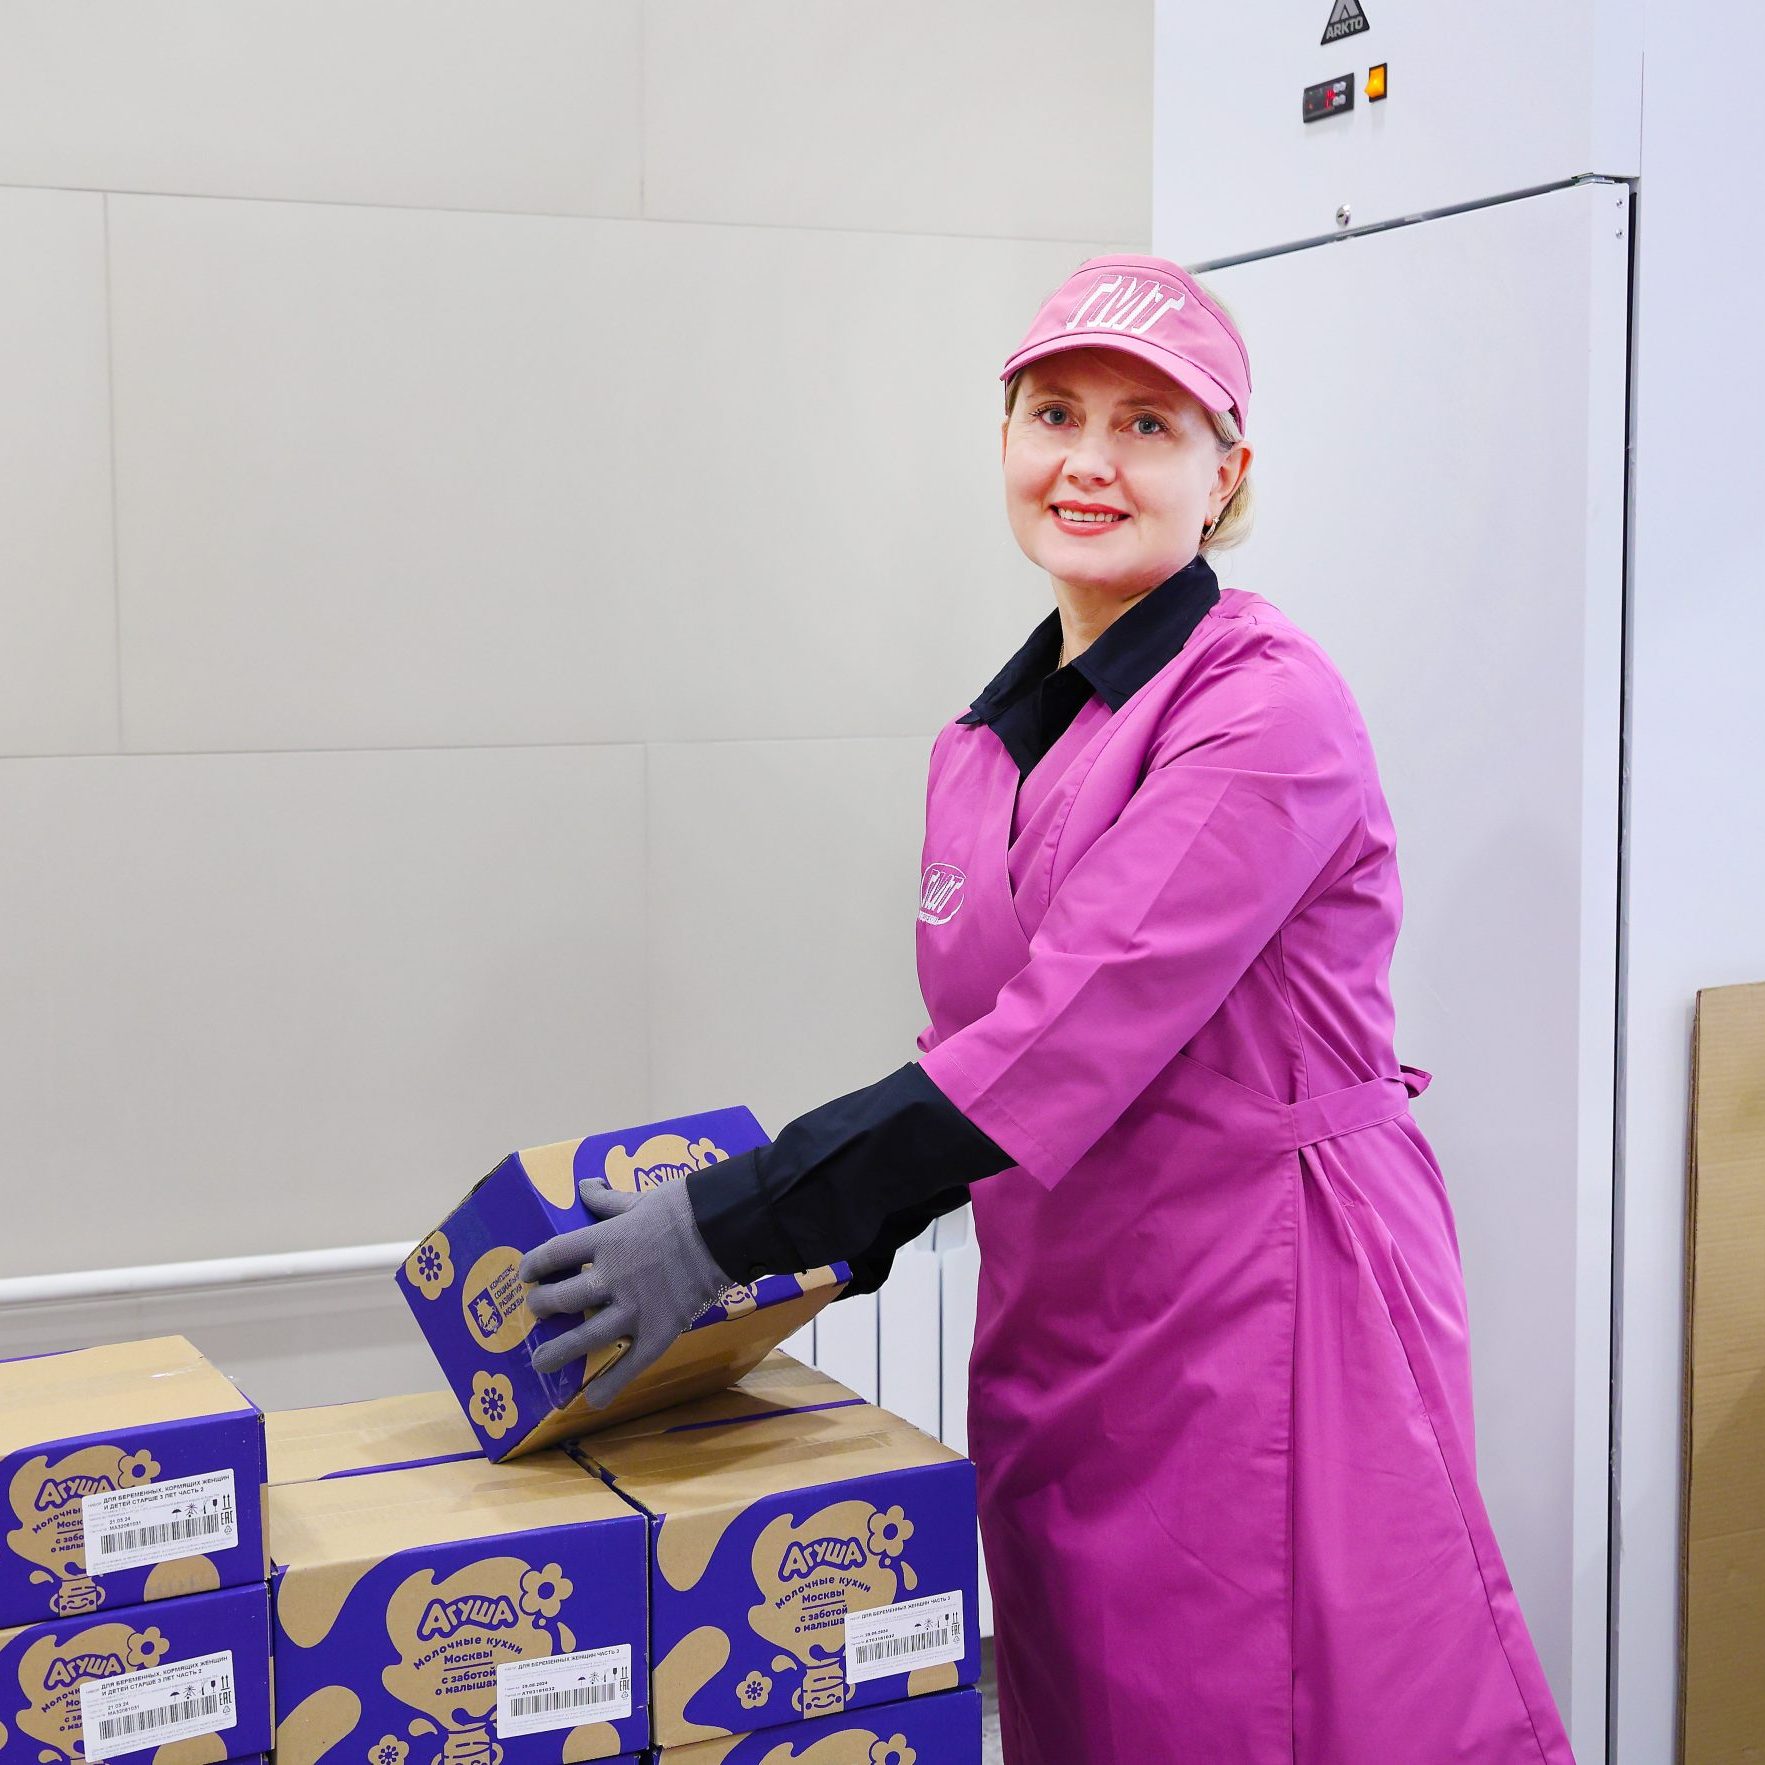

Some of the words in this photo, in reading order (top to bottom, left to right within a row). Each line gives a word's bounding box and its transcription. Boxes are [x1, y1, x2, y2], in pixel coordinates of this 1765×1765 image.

[1325, 16, 1364, 39] ARKTO
[489, 1264, 515, 1291] КОМПЛЕКС
[499, 1283, 524, 1309] РАЗВИТИЯ
[503, 1295, 525, 1318] МОСКВЫ
[103, 1496, 117, 1504] ДЛЯ
[165, 1481, 201, 1493] КОРМЯЩИХ
[202, 1475, 230, 1486] ЖЕНЩИН
[110, 1500, 131, 1510] ДЕТЕЙ
[132, 1495, 159, 1505] СТАРШЕ
[164, 1491, 177, 1499] ЛЕТ
[178, 1488, 199, 1497] ЧАСТЬ
[32, 1507, 82, 1534] Молочны
[57, 1520, 83, 1530] Моск
[59, 1542, 84, 1552] малы
[63, 1533, 84, 1543] забо
[779, 1538, 866, 1580] АГУША
[839, 1577, 871, 1592] кухни
[802, 1589, 844, 1603] Москвы
[418, 1596, 518, 1639] АГУША
[808, 1605, 848, 1621] заботой
[861, 1612, 873, 1620] ДЛЯ
[803, 1618, 845, 1632] малыша
[486, 1637, 523, 1655] кухни
[444, 1650, 493, 1664] Москвы
[518, 1662, 531, 1670] ДЛЯ
[45, 1654, 125, 1689] АГУША
[101, 1682, 115, 1690] ДЛЯ
[163, 1662, 199, 1675] КОРМЯЩИХ
[200, 1656, 228, 1667] ЖЕНЩИН
[442, 1676, 448, 1684] с
[451, 1666, 496, 1683] заботой
[107, 1685, 129, 1697] ДЕТЕЙ
[130, 1680, 157, 1690] СТАРШЕ
[162, 1675, 175, 1684] ЛЕТ
[177, 1670, 198, 1680] ЧАСТЬ
[435, 1688, 442, 1696] о
[41, 1687, 80, 1713] Молочн
